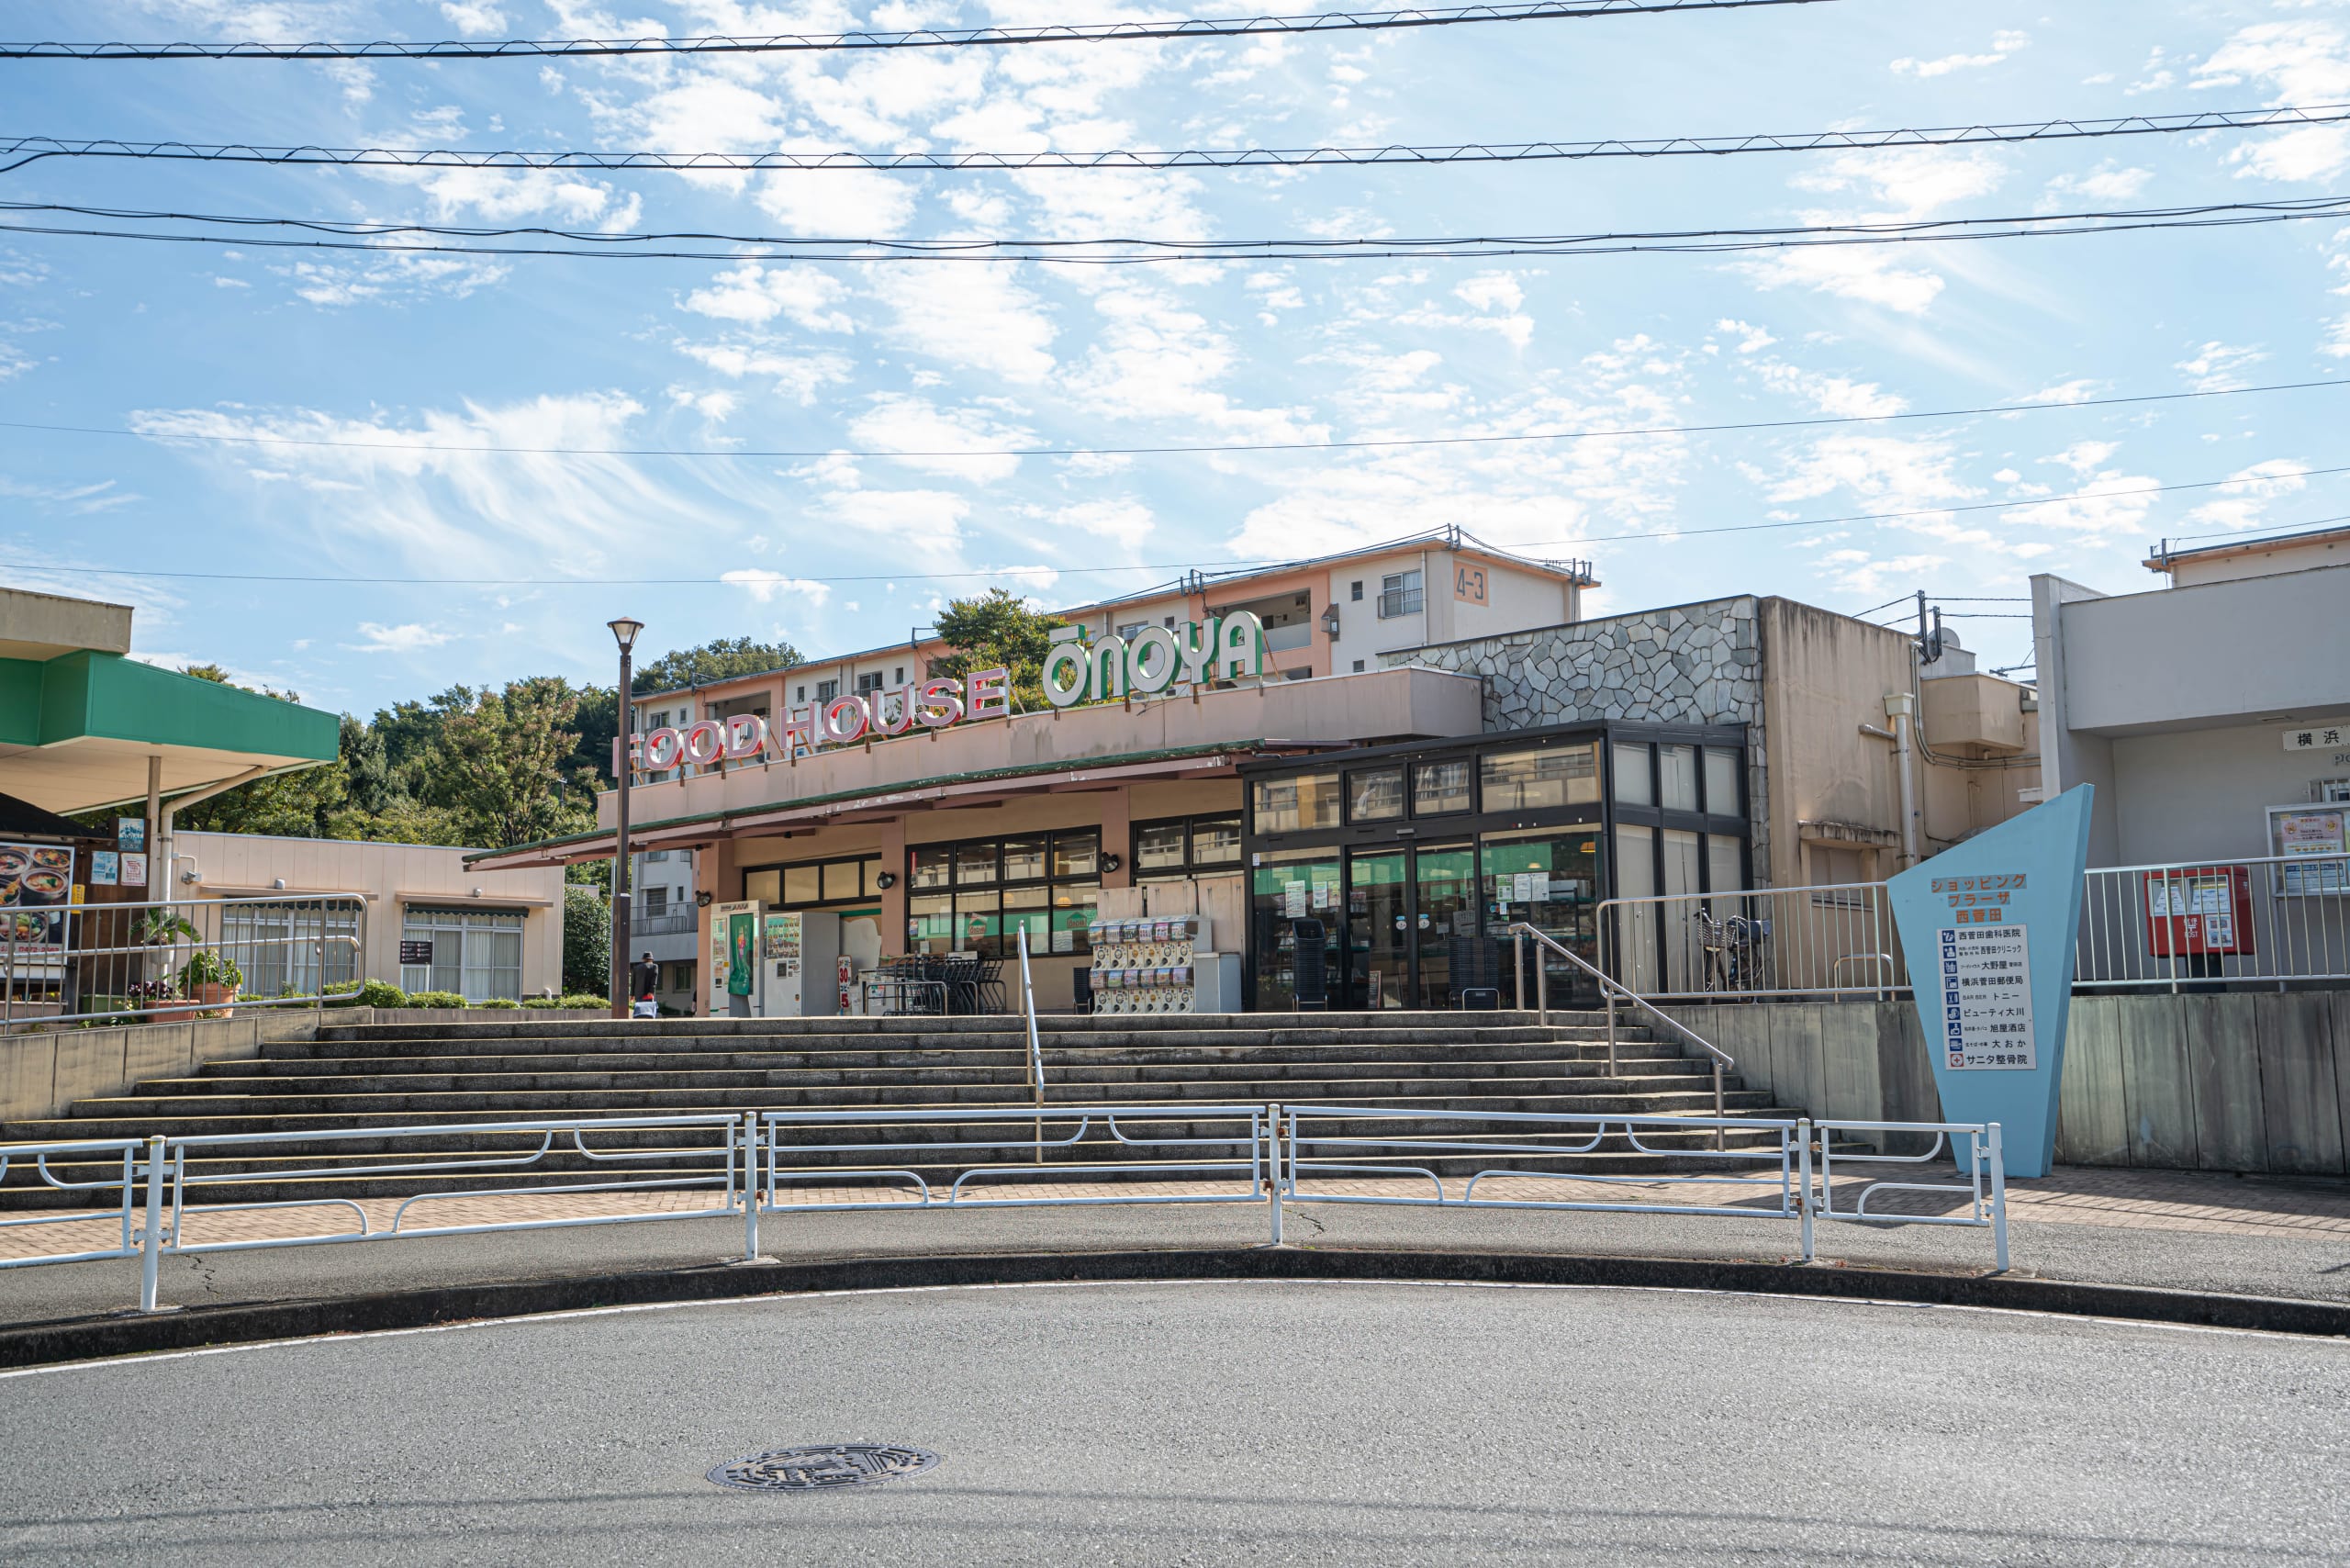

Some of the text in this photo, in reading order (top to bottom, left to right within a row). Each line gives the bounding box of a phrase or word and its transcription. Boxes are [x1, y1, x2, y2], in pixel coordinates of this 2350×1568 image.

[1456, 567, 1484, 600] 4-3
[612, 713, 767, 778] FOOD
[779, 667, 1010, 751] HOUSE
[2298, 729, 2340, 747] 横浜
[1931, 874, 2025, 893] ショッピング
[1956, 908, 2001, 924] 西菅田
[1958, 928, 2021, 940] 西菅田歯科医院
[1980, 944, 2021, 955] 西菅田クリニック
[1981, 960, 2008, 970] 大野屋
[1962, 975, 2023, 987] 横浜菅田郵便局
[1994, 992, 2020, 1002] トニー
[1964, 1006, 2025, 1017] ビューティ大川
[1990, 1023, 2026, 1033] 旭屋酒店
[1992, 1038, 2027, 1048] 大おか
[1966, 1054, 2028, 1065] サニタ整骨院
